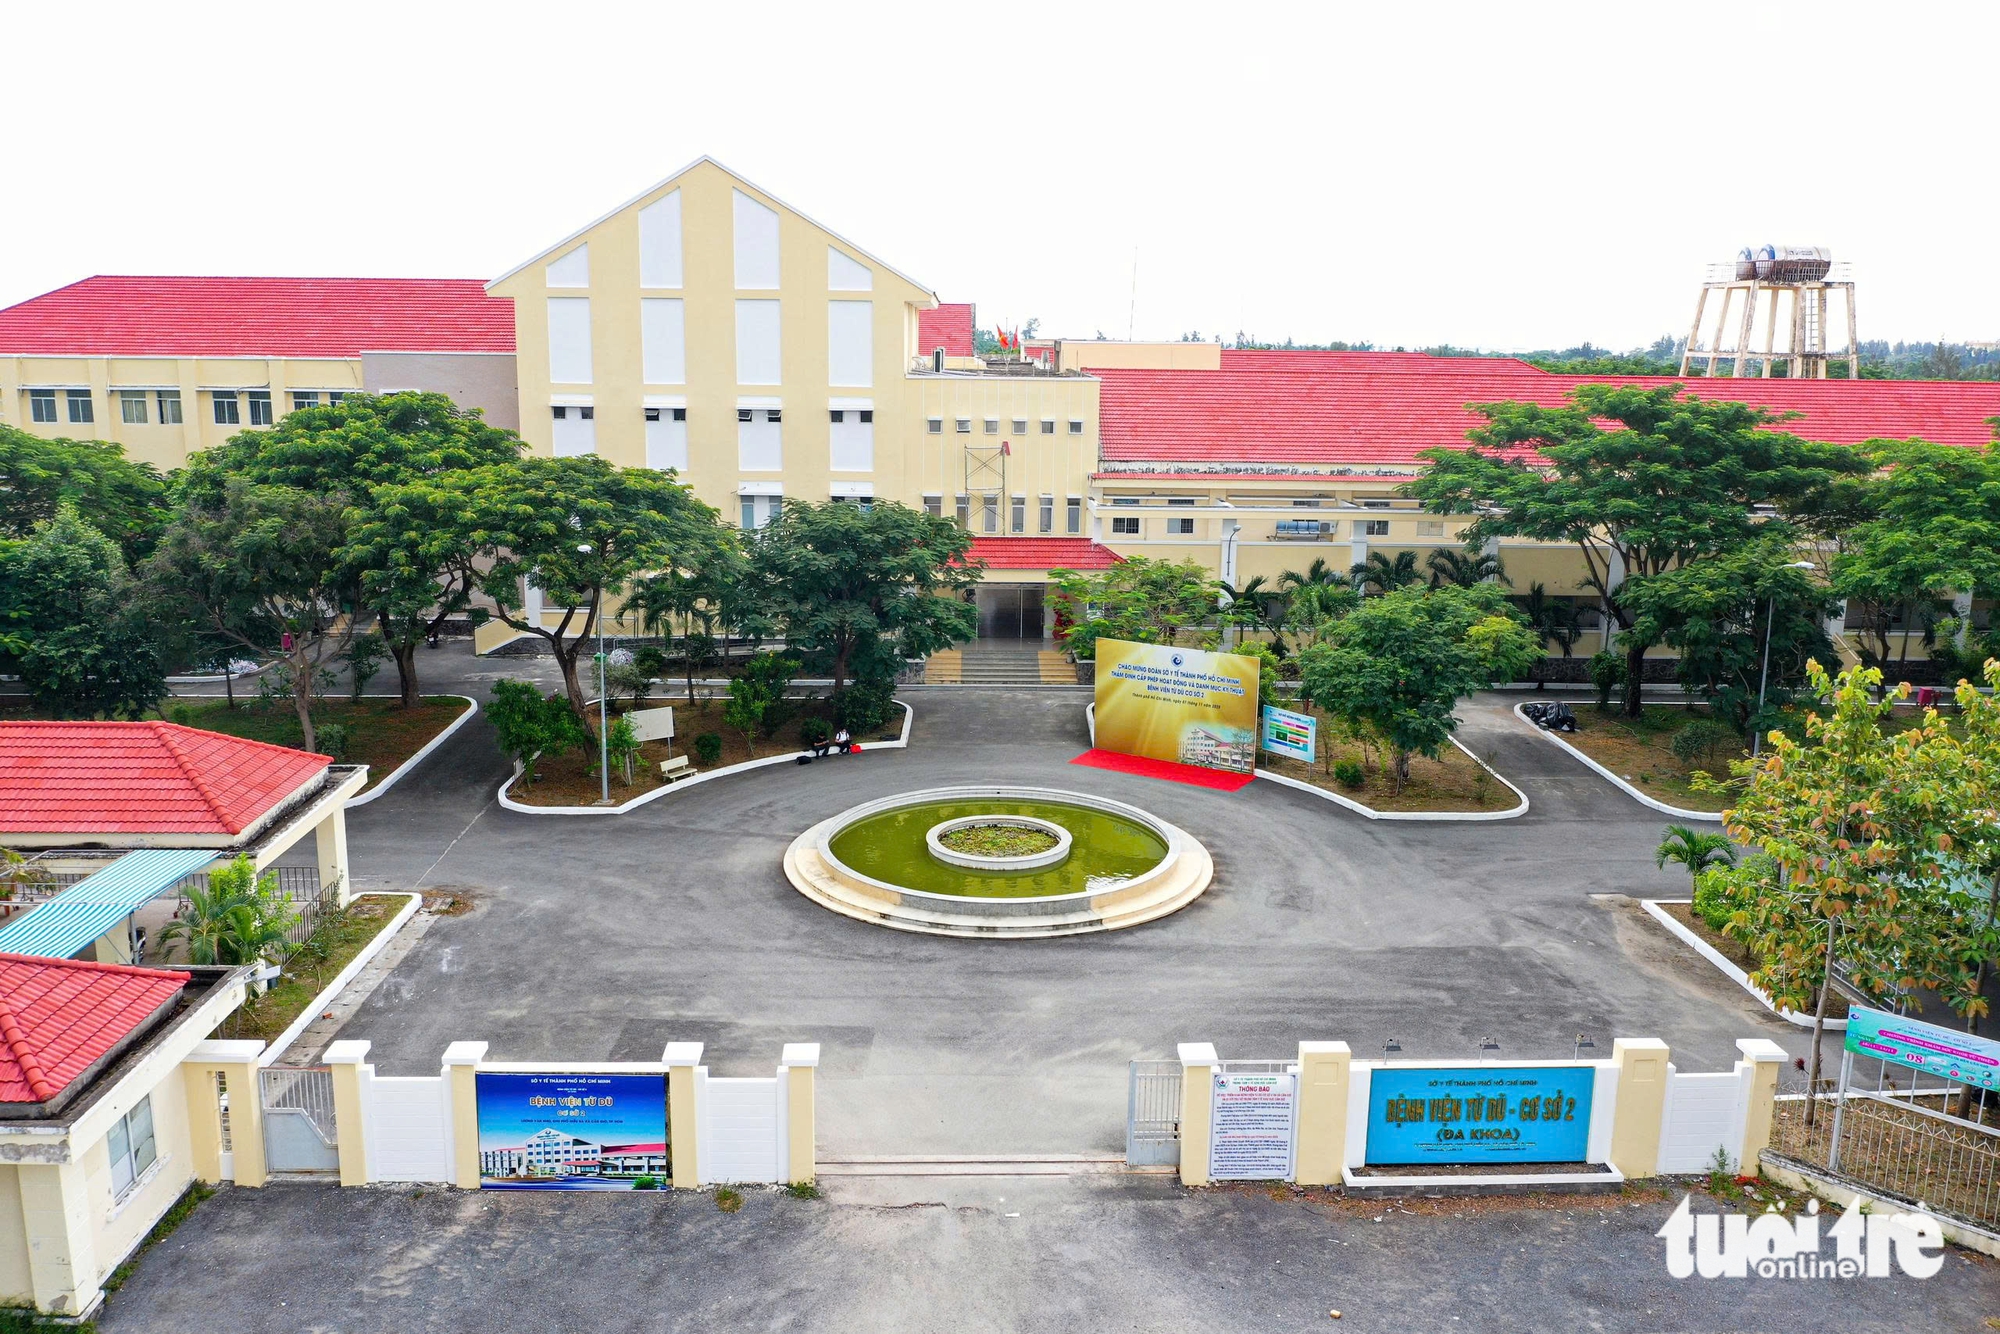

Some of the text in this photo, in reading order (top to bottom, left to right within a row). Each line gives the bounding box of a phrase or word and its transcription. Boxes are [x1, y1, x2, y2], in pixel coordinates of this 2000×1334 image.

[1197, 672, 1207, 681] PHỐ
[1196, 682, 1209, 690] DANH
[1906, 1053, 1923, 1063] 08
[530, 1095, 613, 1108] BỆNH VIỆN TỪ DŨ
[1387, 1093, 1425, 1128] BỆNH
[1429, 1093, 1462, 1127] VIỆN
[1466, 1092, 1486, 1121] TỪ
[1487, 1092, 1506, 1121] DŨ
[1520, 1094, 1541, 1121] CƠ
[1543, 1089, 1564, 1121] SỞ
[1565, 1097, 1575, 1121] 2
[1437, 1127, 1520, 1142] (ĐA KHOA)
